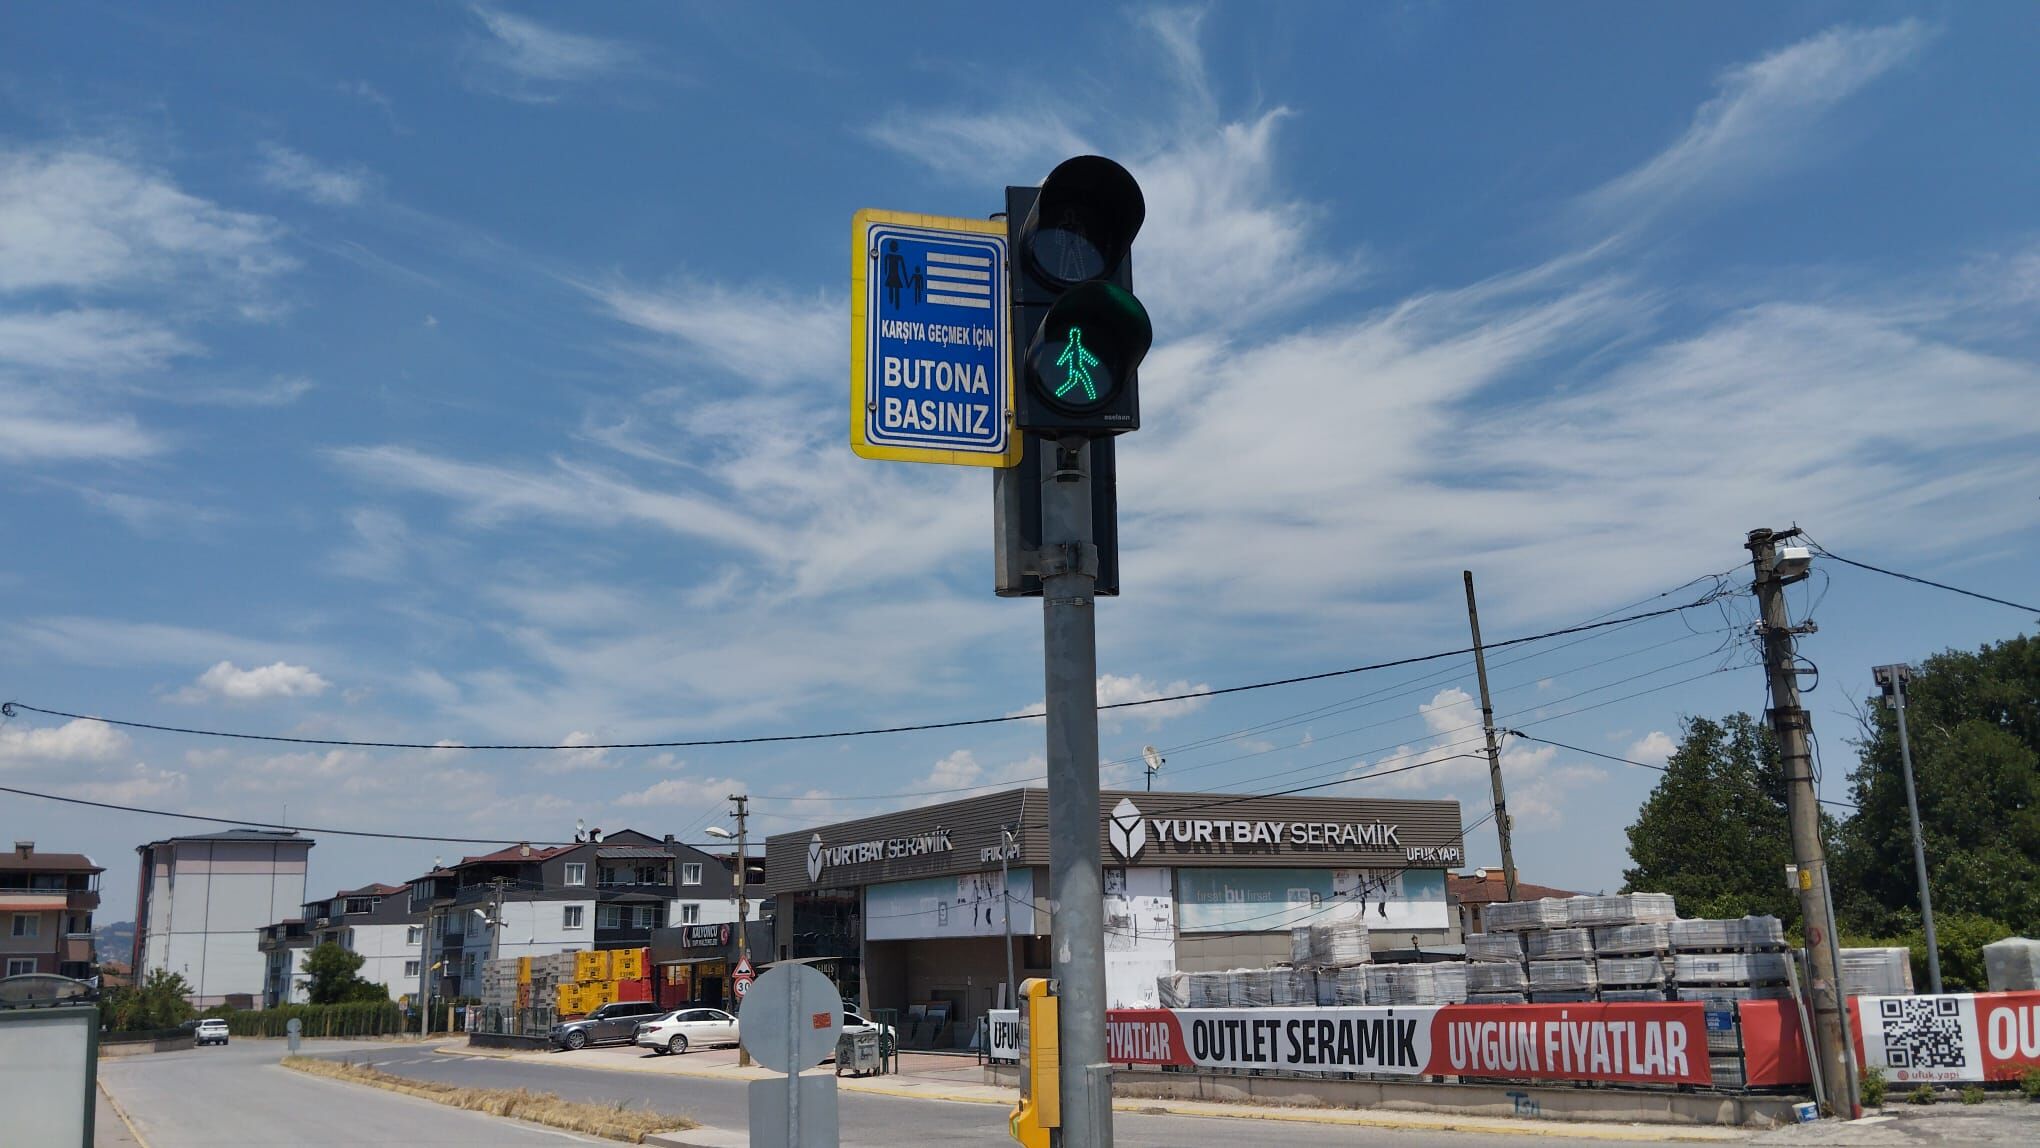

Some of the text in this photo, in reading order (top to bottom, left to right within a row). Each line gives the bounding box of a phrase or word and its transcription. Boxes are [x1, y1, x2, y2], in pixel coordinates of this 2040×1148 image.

[881, 319, 994, 351] KARŞIYA GEÇMEK İÇİN
[884, 356, 990, 395] BUTONA
[884, 397, 990, 435] BASINIZ
[823, 825, 953, 867] YURTBAY SERAMİK
[1150, 819, 1400, 846] YURTBAY SERAMİK
[980, 847, 1003, 862] UFUK
[1406, 847, 1460, 861] UFUK YAPI
[1224, 884, 1244, 903] bu
[1193, 1009, 1418, 1067] OUTLET SERAMİK
[1448, 1010, 1689, 1076] UYGUN FİYATLAR
[1988, 1006, 2040, 1059] OU
